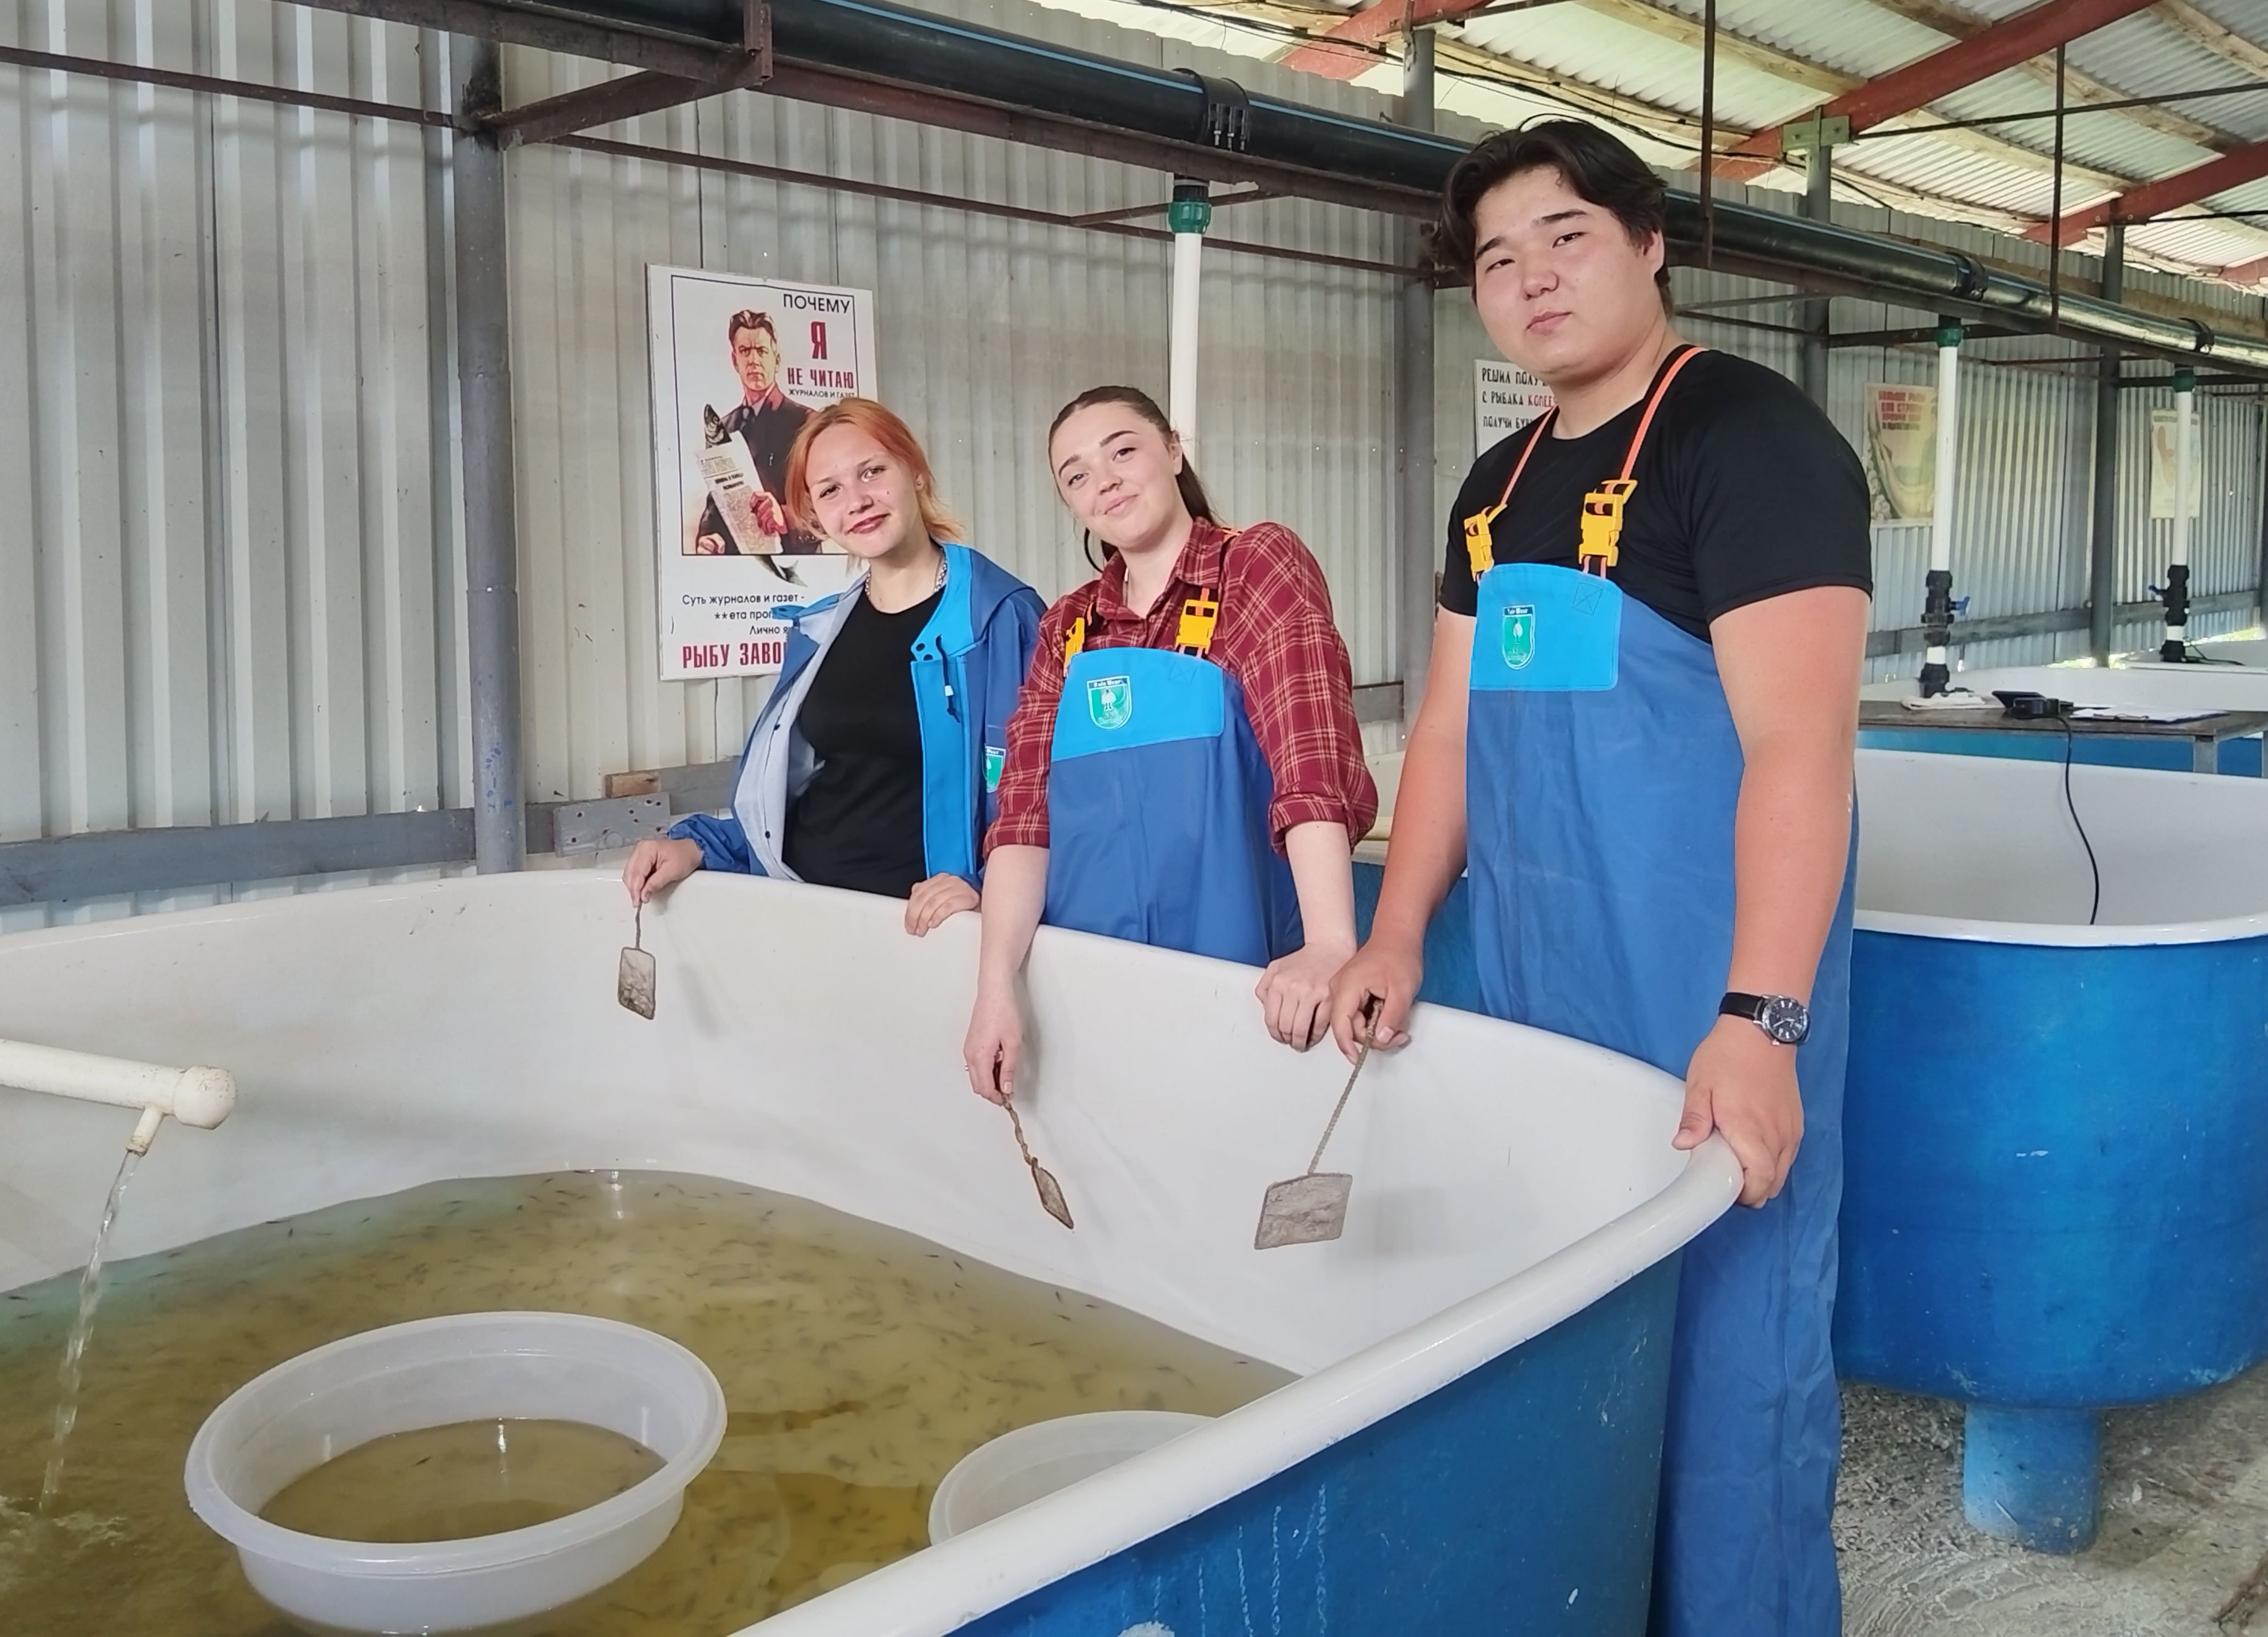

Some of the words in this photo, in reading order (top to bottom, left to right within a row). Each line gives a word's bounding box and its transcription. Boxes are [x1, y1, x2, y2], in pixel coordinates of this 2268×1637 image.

[784, 294, 850, 314] ПОЧЕМУ
[811, 321, 828, 360] Я
[787, 367, 803, 385] НЕ
[810, 369, 854, 389] ЧИТАЮ
[1482, 368, 1510, 384] РЕШИЛ
[789, 389, 828, 398] ЖУРНАЛОВ
[1483, 391, 1488, 403] С
[1491, 391, 1524, 406] РЫБАКА
[1483, 416, 1512, 428] ПОЛУЧИ
[682, 595, 706, 607] Суть
[709, 595, 761, 606] журналов
[773, 594, 798, 603] газет
[749, 625, 780, 635] Лично
[683, 644, 730, 669] РЫБУ
